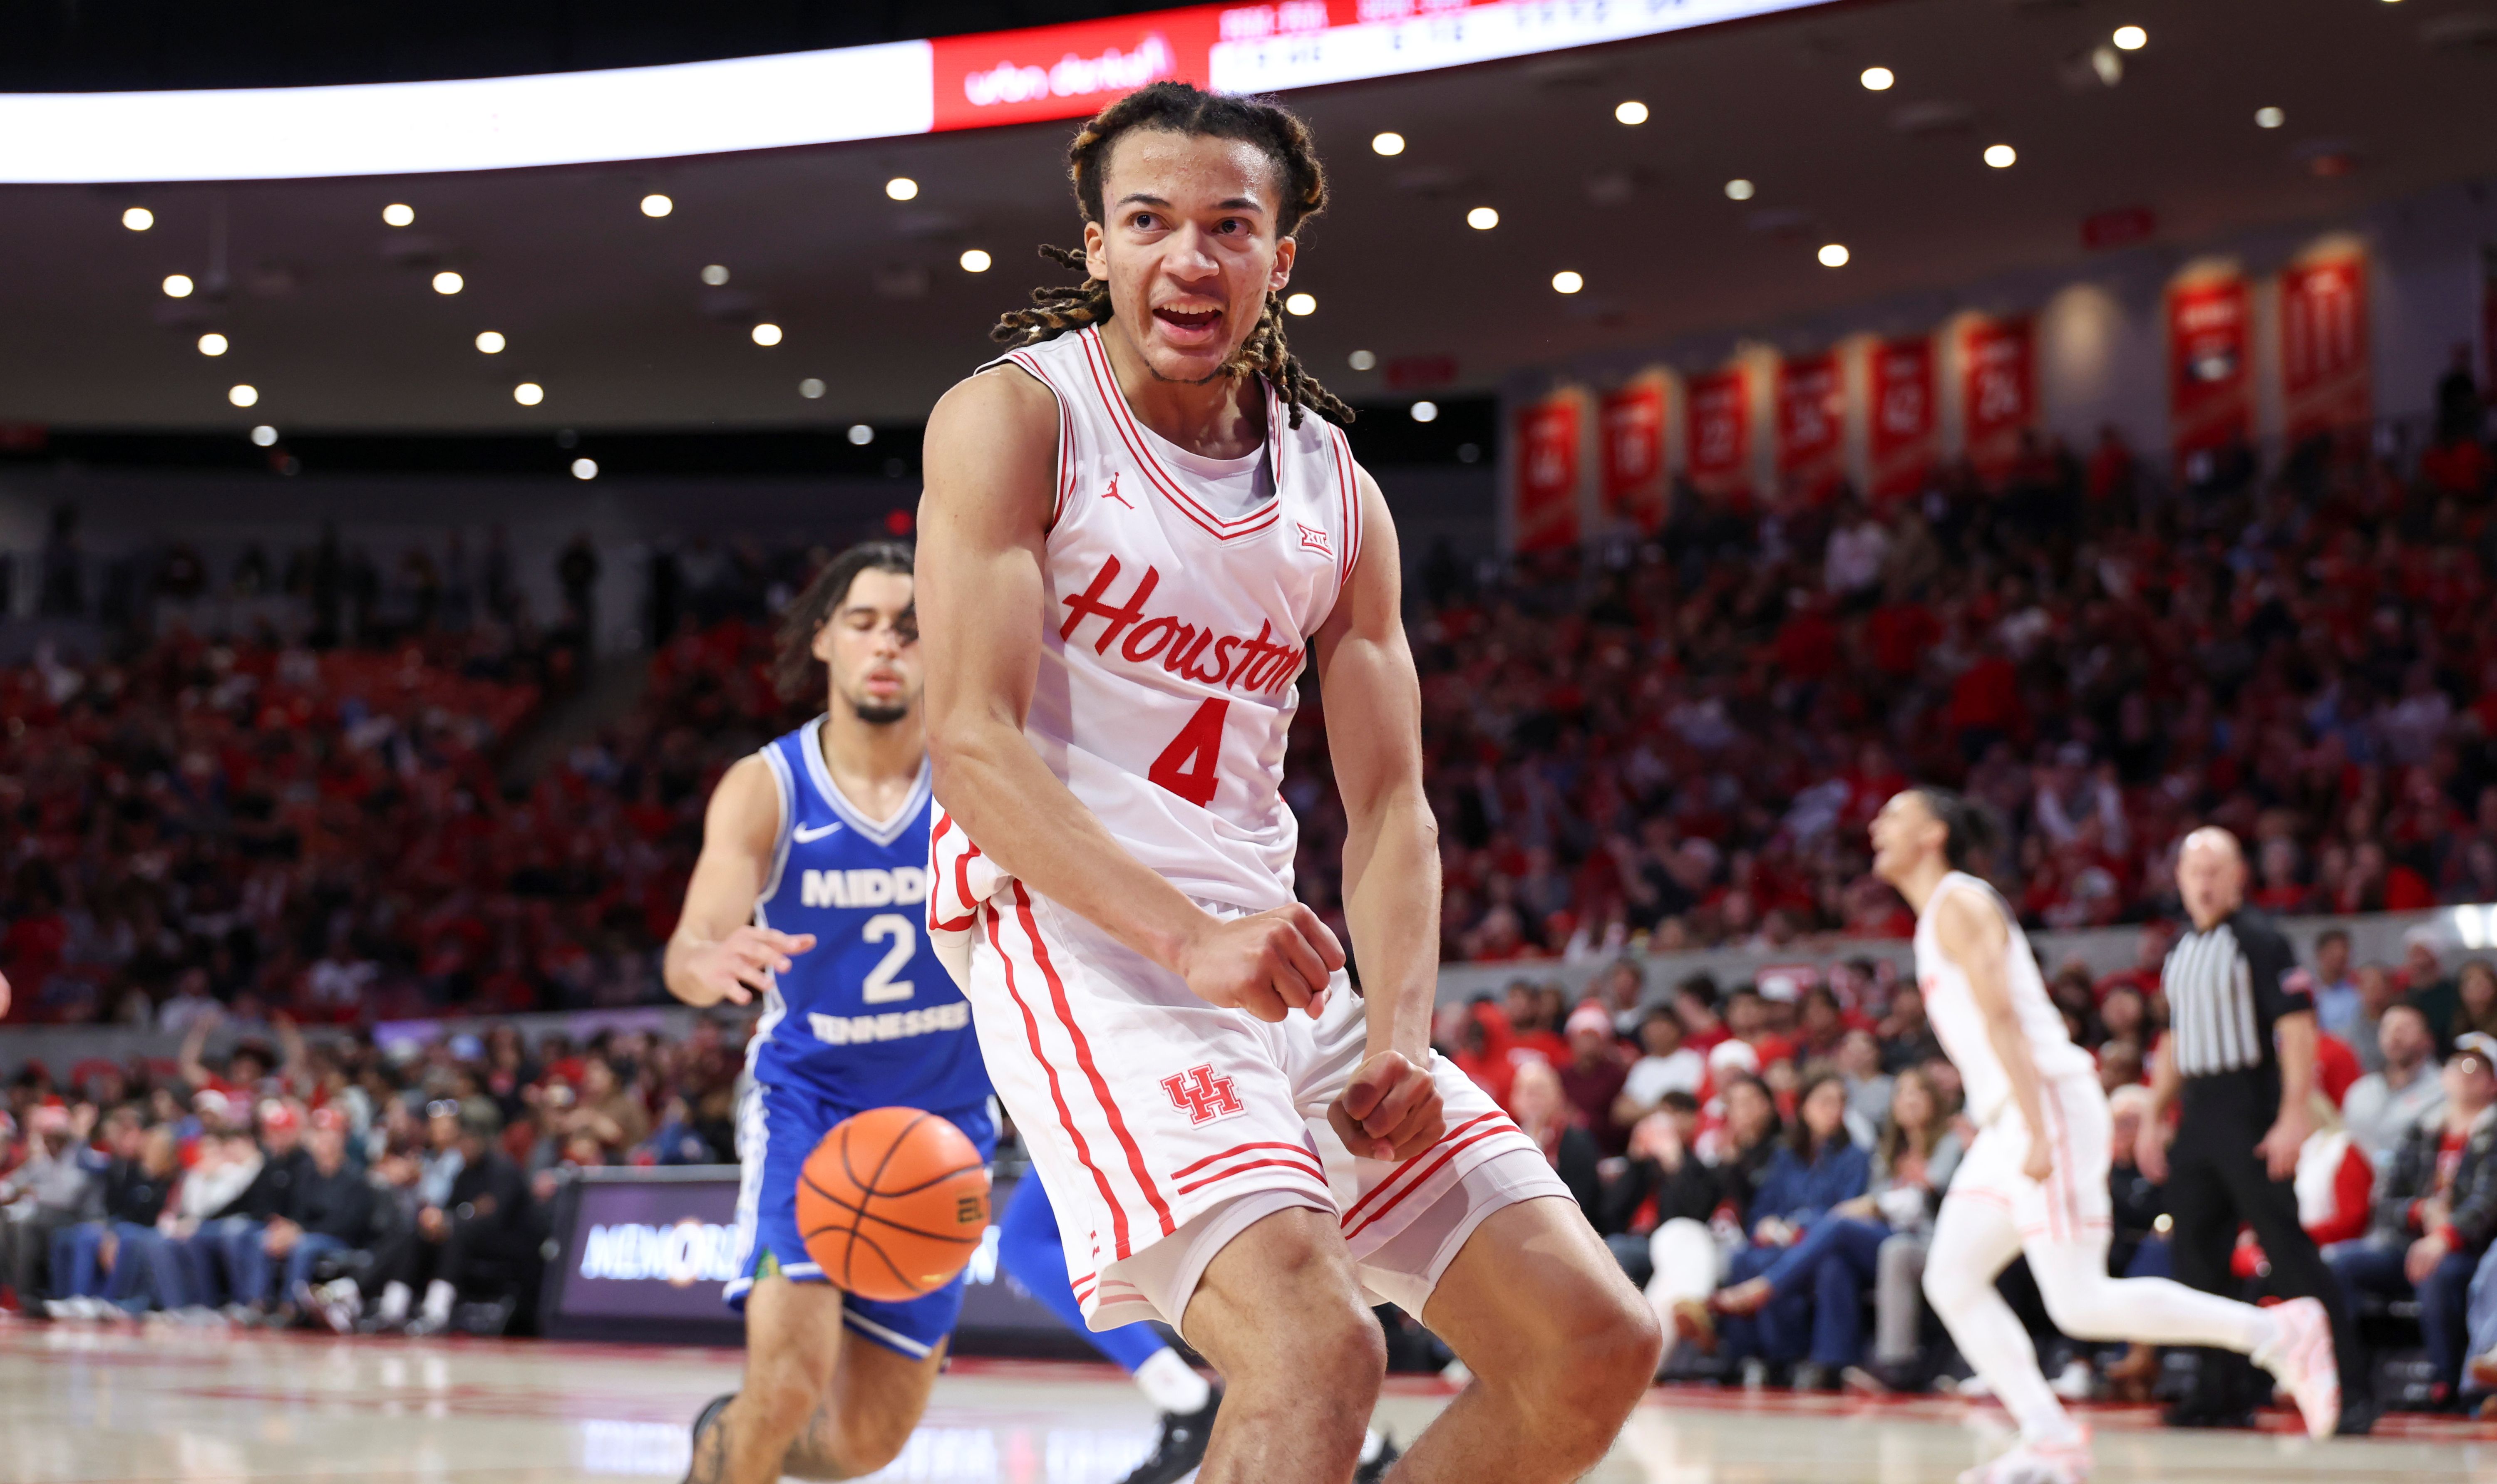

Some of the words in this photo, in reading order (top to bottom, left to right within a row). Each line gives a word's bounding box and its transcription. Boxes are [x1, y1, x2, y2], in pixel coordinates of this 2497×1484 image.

[1060, 553, 1306, 695] Houston
[1148, 697, 1230, 808] 4
[800, 865, 928, 909] MIDD
[862, 913, 916, 1005] 2
[807, 999, 971, 1046] TENNESSEE
[1160, 1063, 1244, 1125] UH
